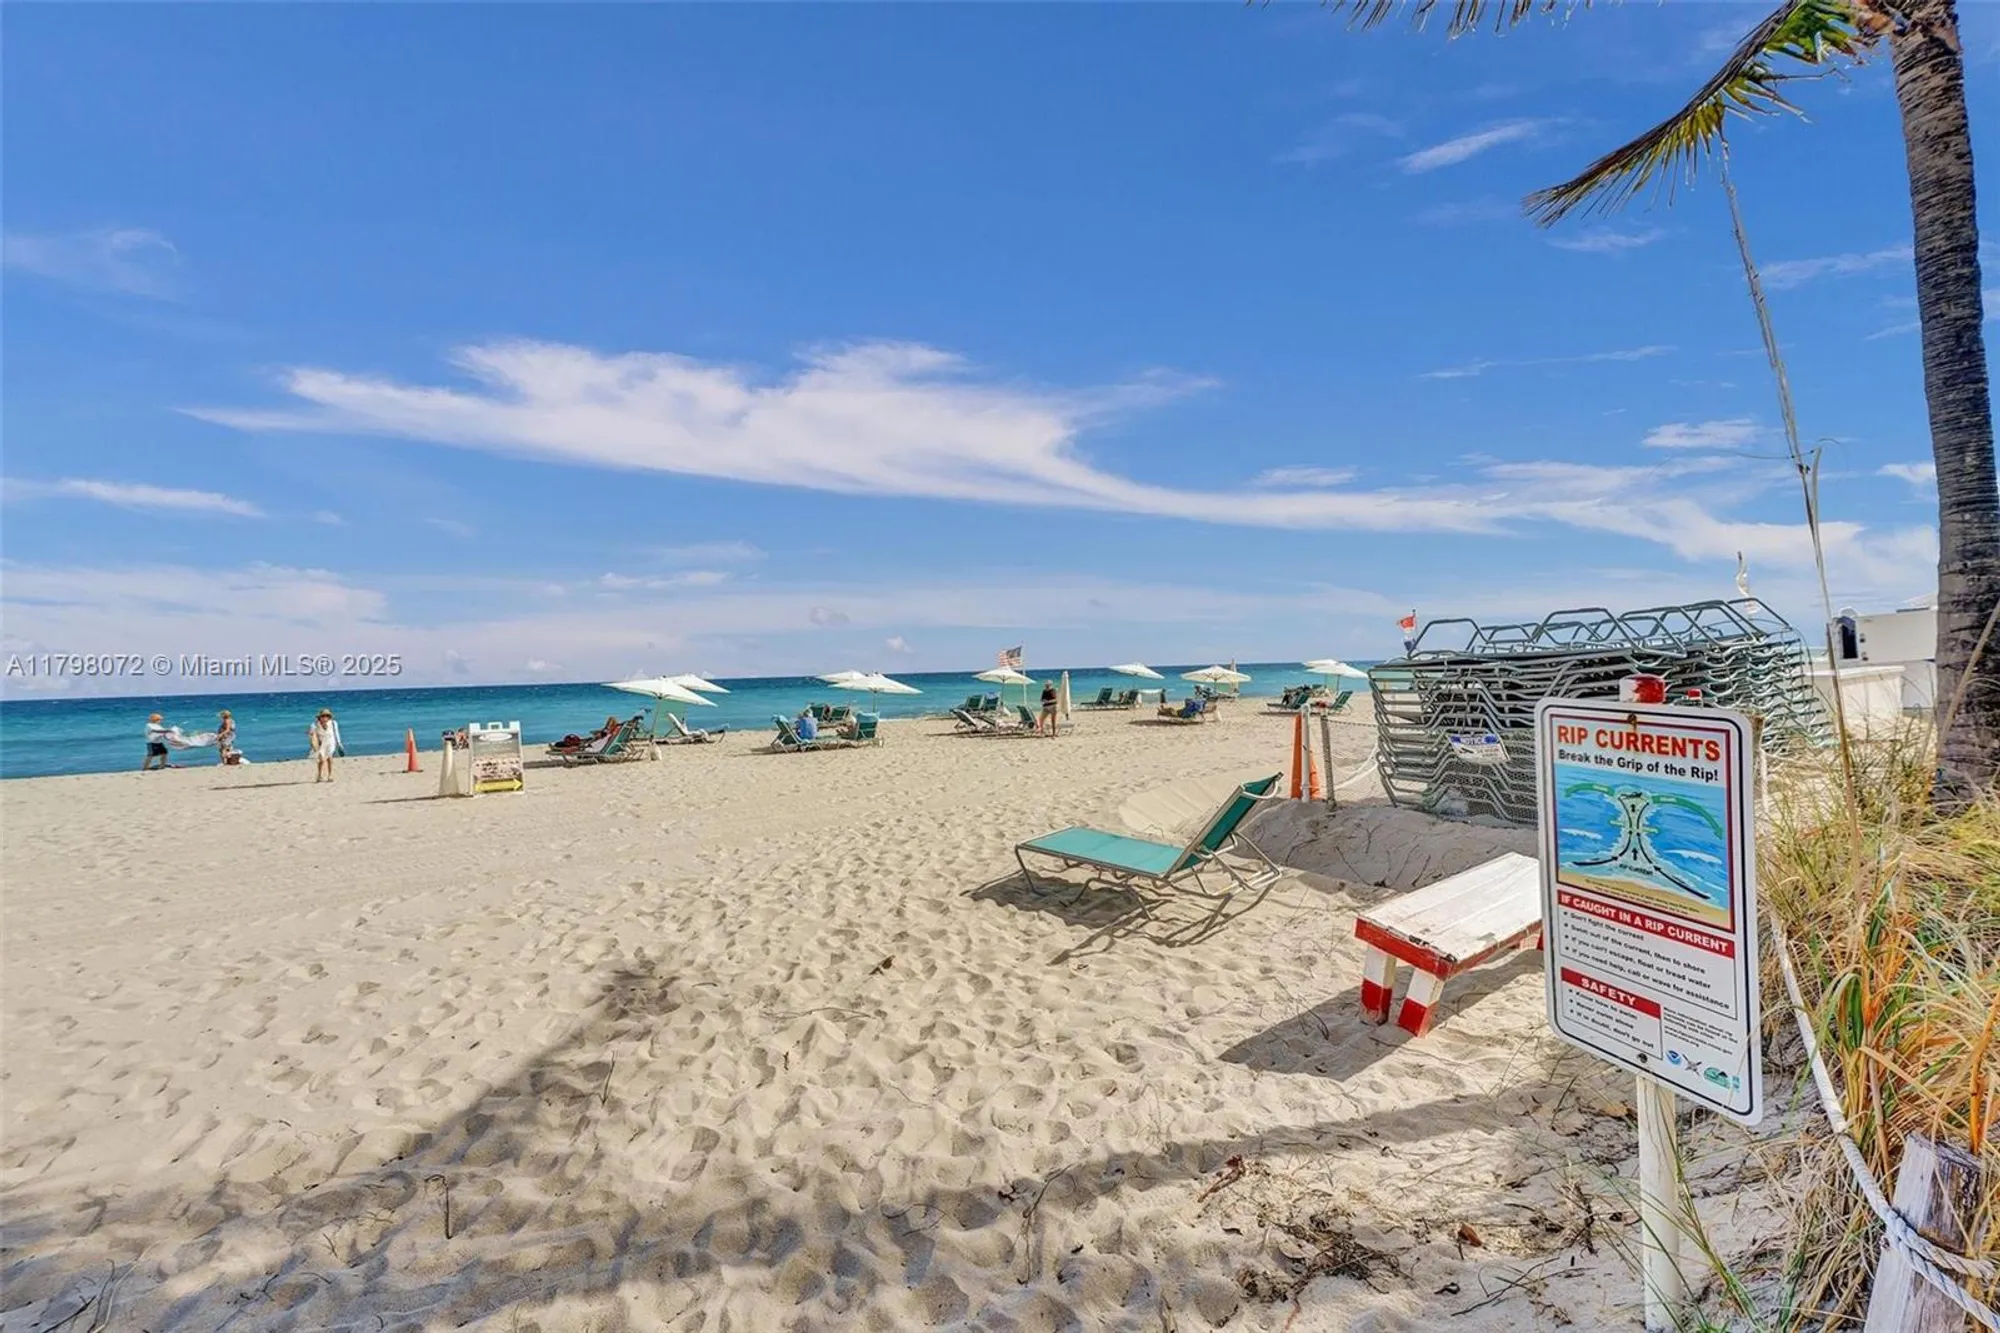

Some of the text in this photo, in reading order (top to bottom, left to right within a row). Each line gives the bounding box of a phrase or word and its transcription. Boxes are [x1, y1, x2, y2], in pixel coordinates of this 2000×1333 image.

[1558, 725, 1720, 762] RIP CURRENTS
[1558, 749, 1718, 783] Break the Grip of the Rip!
[1561, 894, 1569, 904] IF
[1573, 898, 1616, 918] CAUGHT
[1619, 911, 1631, 923] IN
[1634, 916, 1643, 927] A
[1645, 920, 1664, 933] RIP
[1668, 926, 1728, 952] CURRENT
[1683, 962, 1706, 974] shore
[1581, 977, 1637, 1006] SAFETY
[1686, 990, 1730, 1009] assistance
